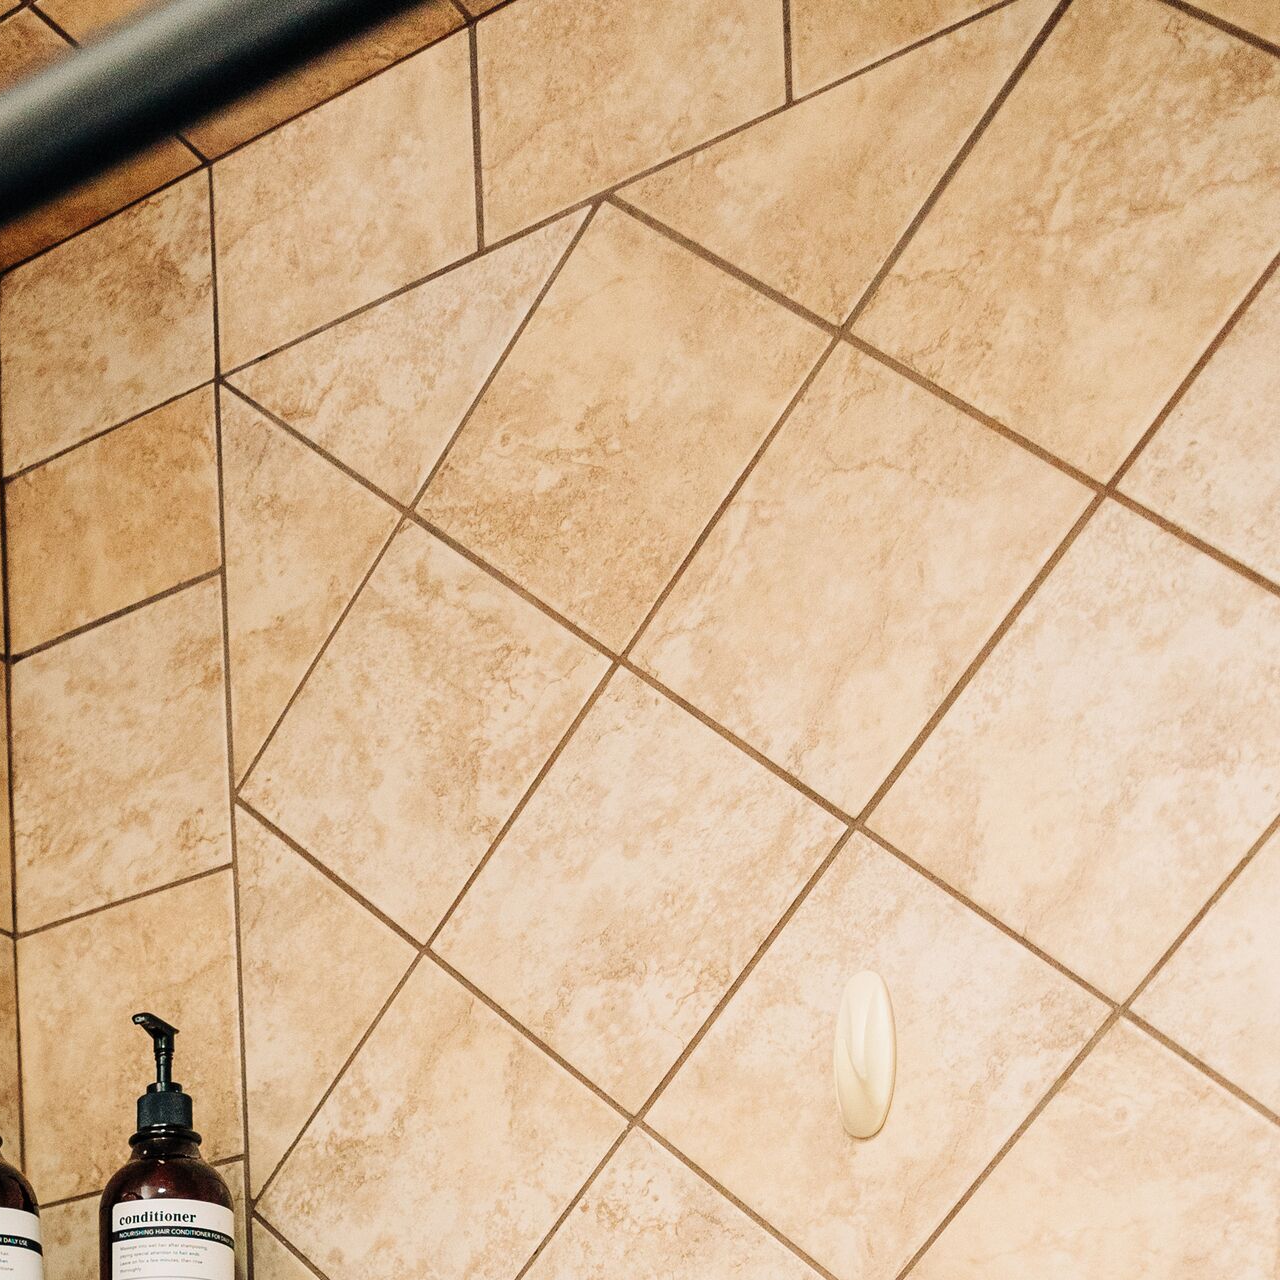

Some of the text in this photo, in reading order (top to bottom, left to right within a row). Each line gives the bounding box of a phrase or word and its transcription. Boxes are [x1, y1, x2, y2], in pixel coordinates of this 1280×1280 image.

[119, 1211, 196, 1226] conditioner
[119, 1229, 154, 1238] NOURISHING
[171, 1228, 210, 1238] CONDITIONER
